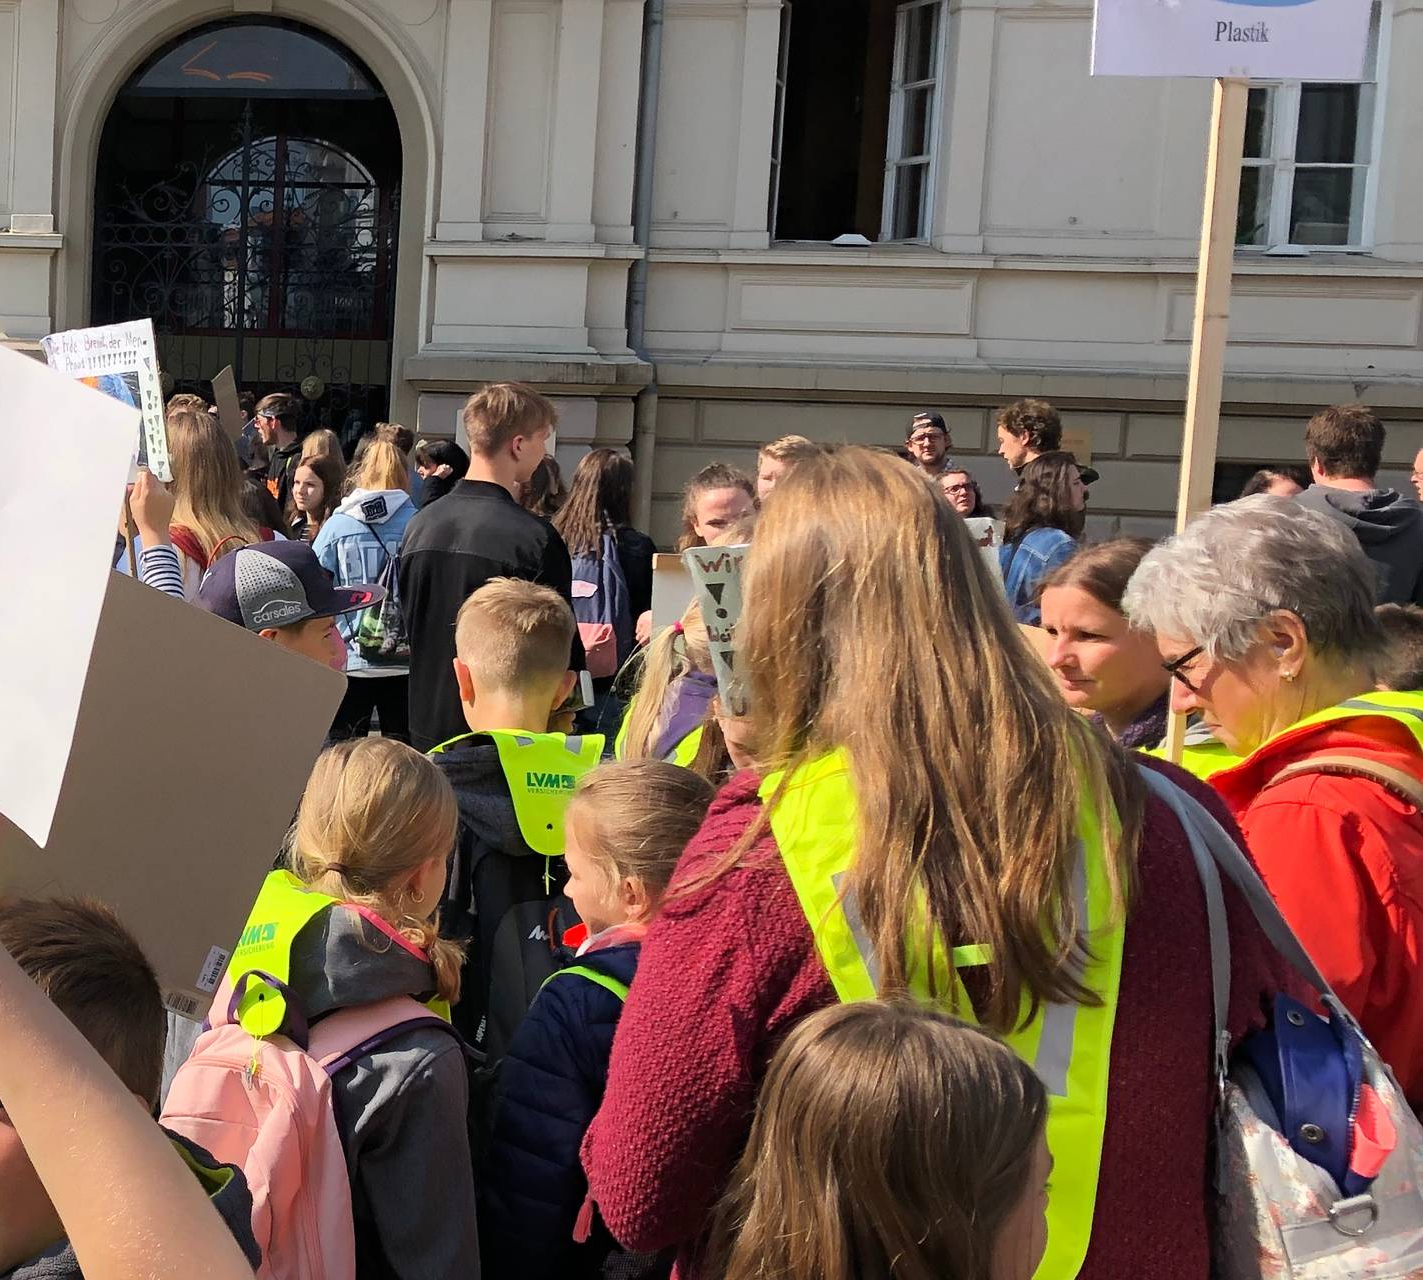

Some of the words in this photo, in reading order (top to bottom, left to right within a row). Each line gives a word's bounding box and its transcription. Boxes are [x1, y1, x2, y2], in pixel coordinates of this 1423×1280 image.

[1215, 21, 1269, 42] Plastik
[695, 553, 743, 573] Wir
[253, 604, 302, 624] carsales
[527, 772, 560, 788] LVM
